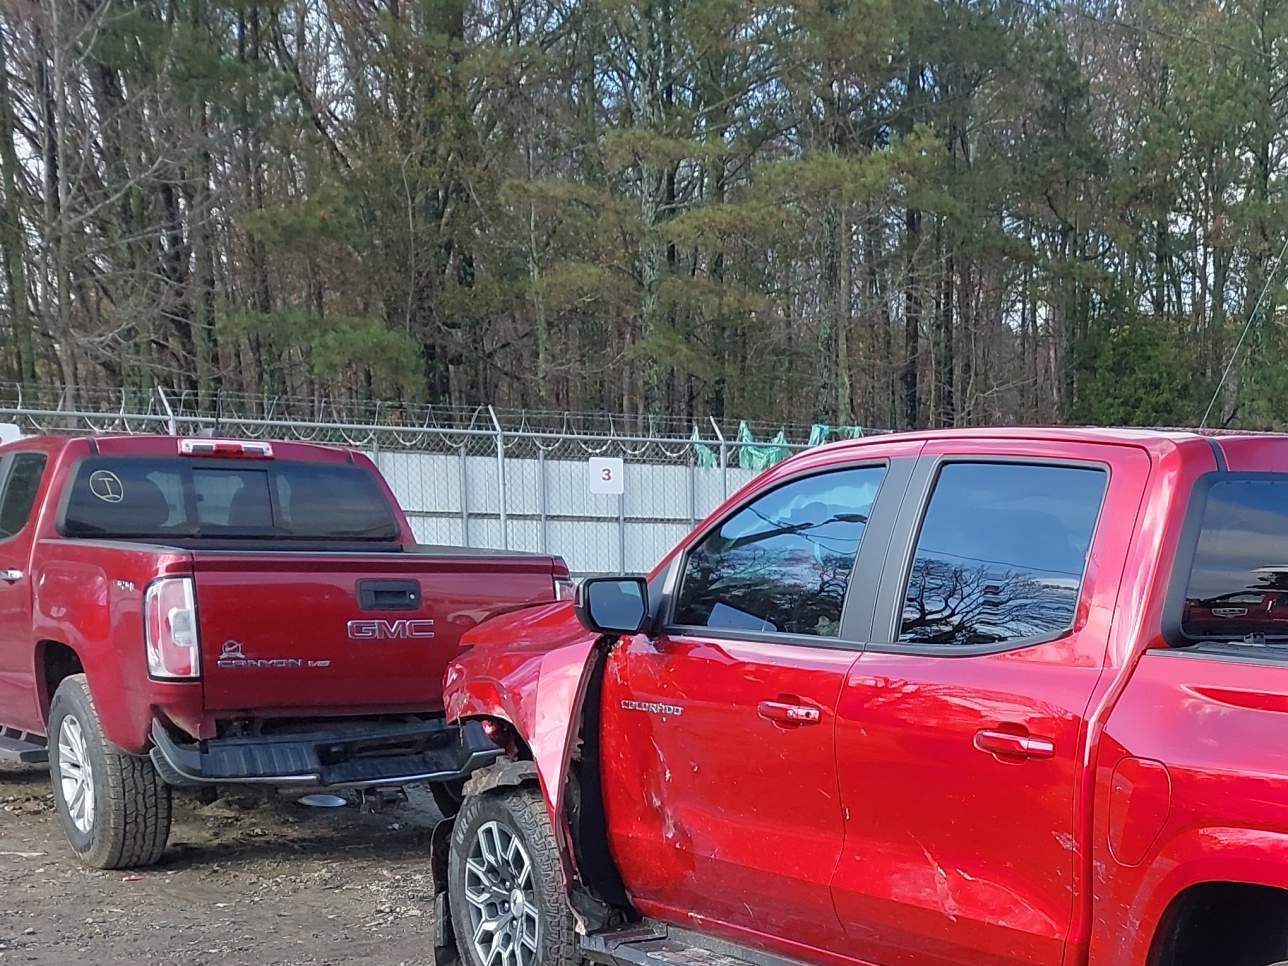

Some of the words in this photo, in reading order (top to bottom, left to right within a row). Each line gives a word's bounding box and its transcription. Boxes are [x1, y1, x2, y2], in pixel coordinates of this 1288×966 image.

[601, 468, 612, 481] 3
[347, 619, 435, 639] GMC
[217, 658, 304, 669] CANYON
[621, 699, 685, 716] COLORADO
